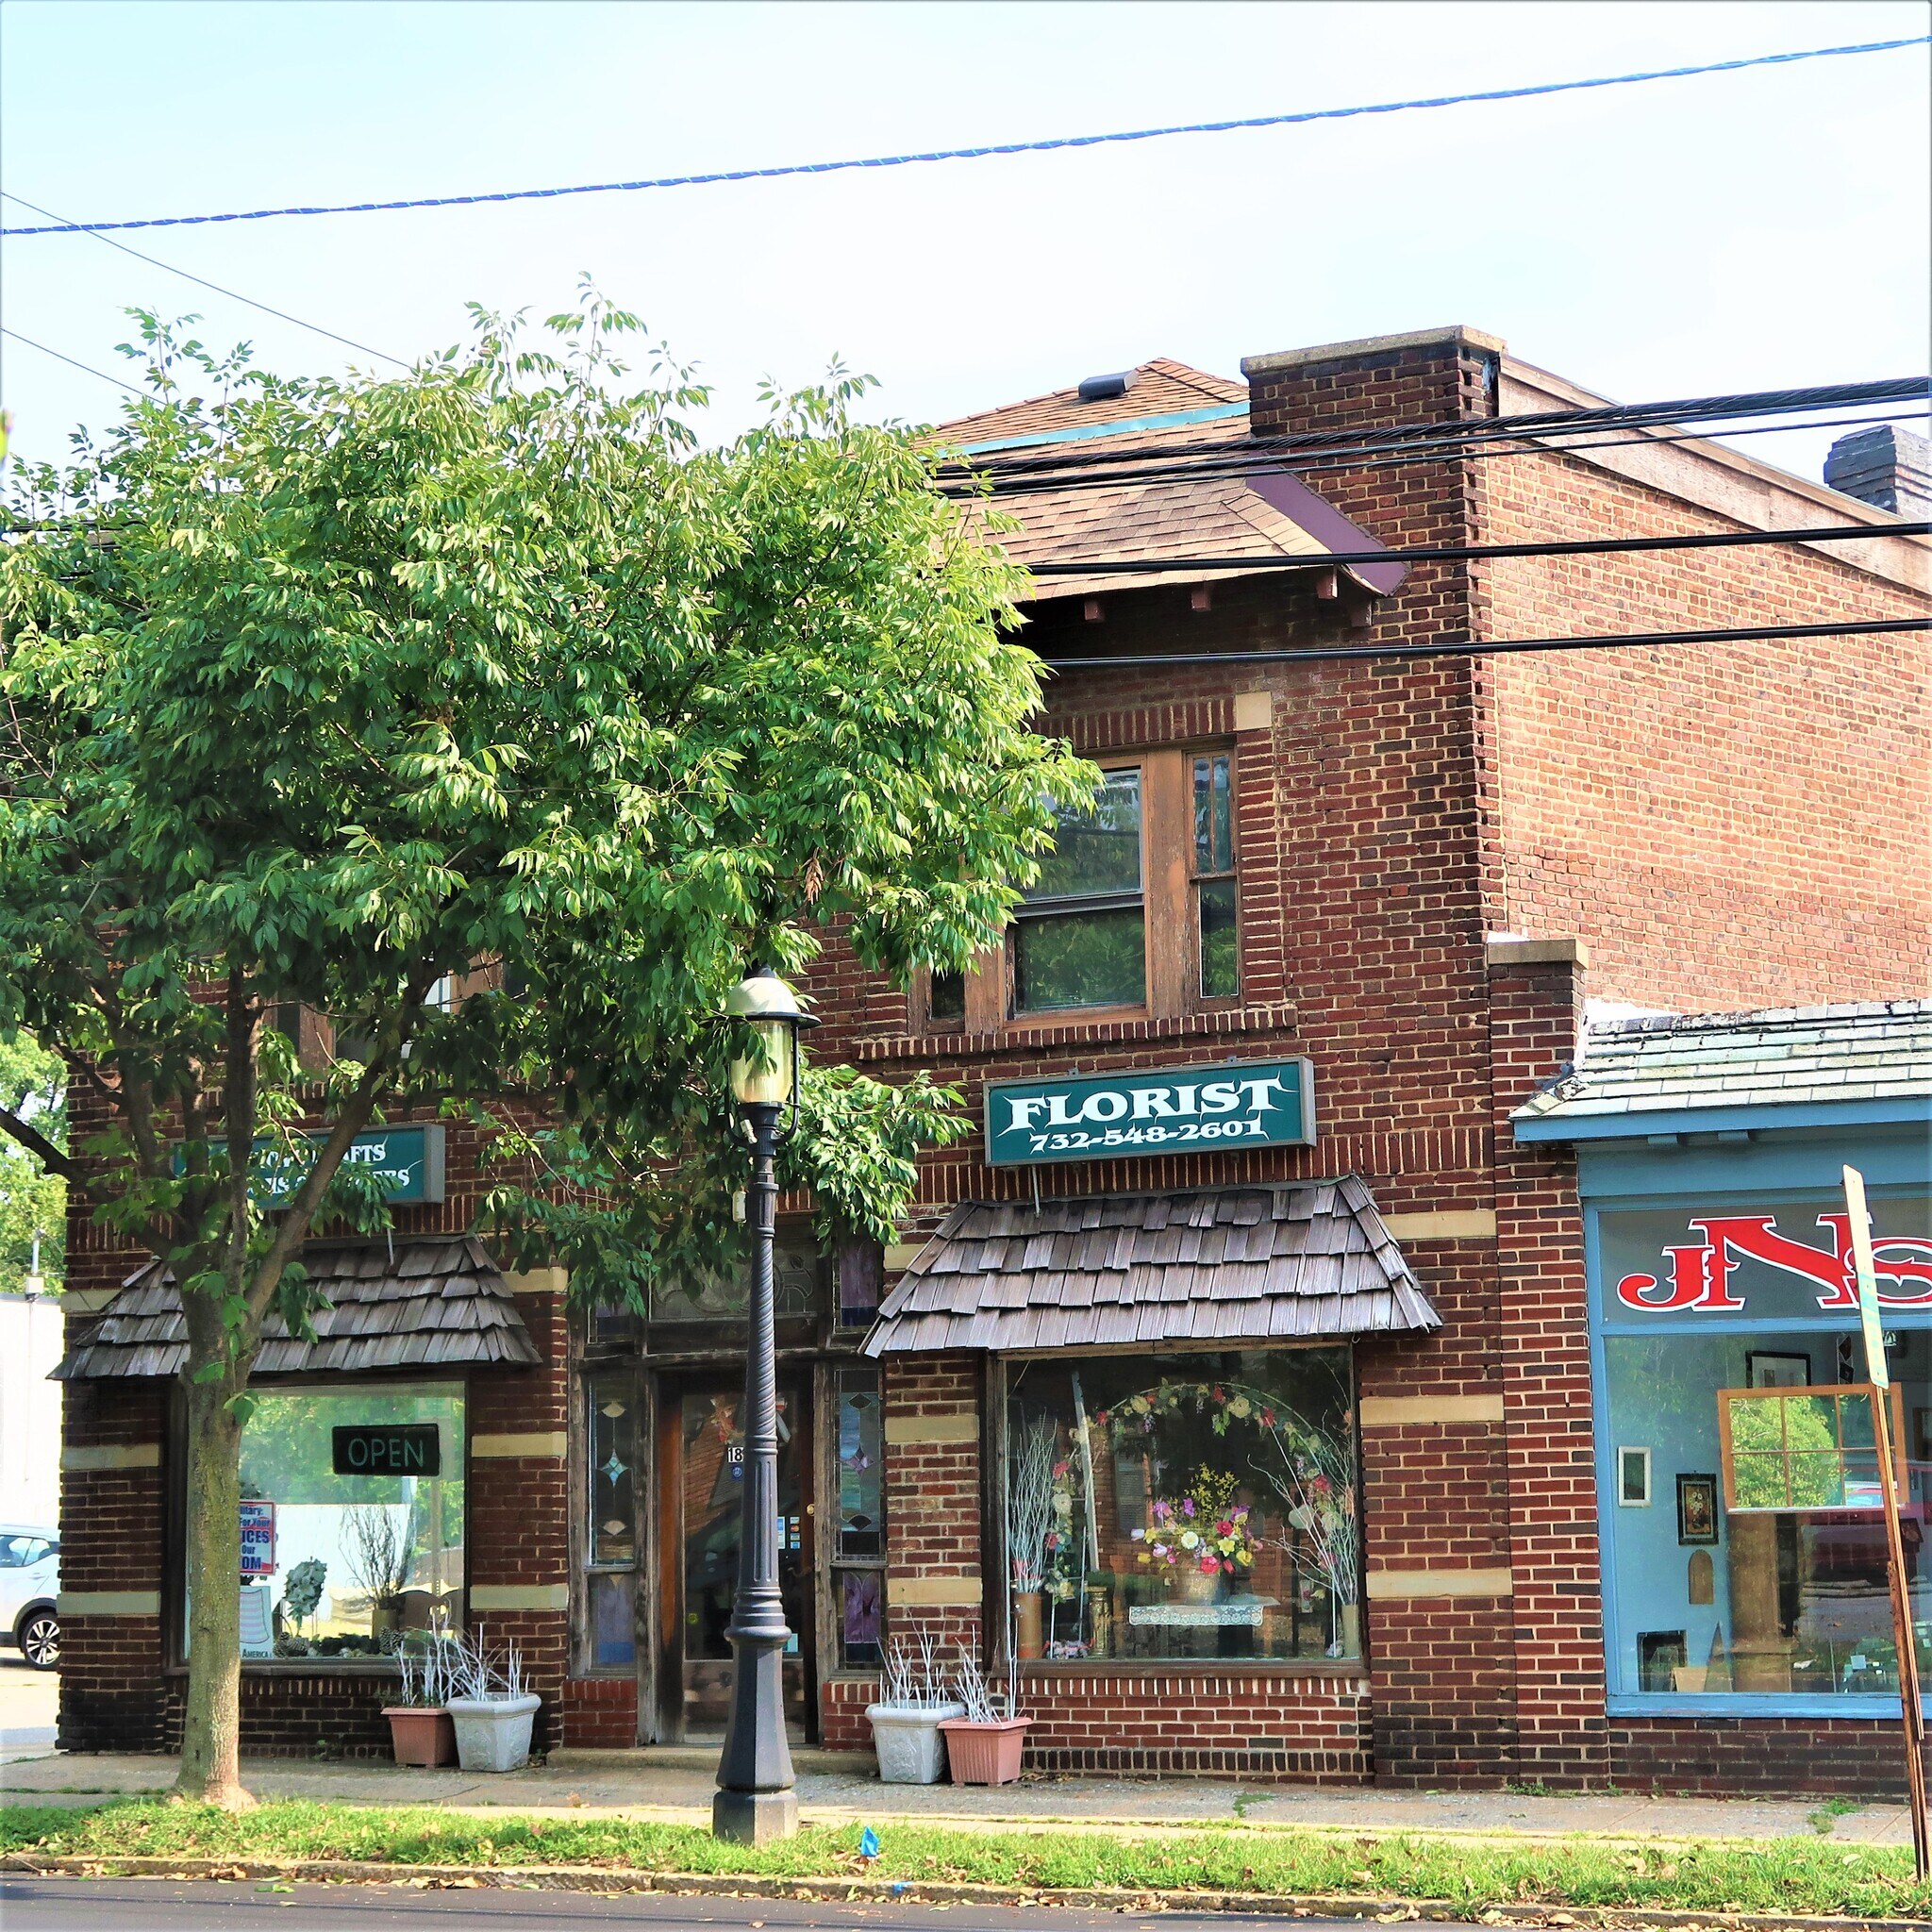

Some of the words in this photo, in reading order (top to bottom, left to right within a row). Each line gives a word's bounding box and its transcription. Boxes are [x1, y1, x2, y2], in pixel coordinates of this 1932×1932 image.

[996, 1070, 1300, 1138] FLORIST
[1029, 1110, 1271, 1156] 732-548-2601
[348, 1438, 424, 1467] OPEN
[242, 1530, 270, 1543] ICES
[242, 1544, 256, 1555] Our
[242, 1557, 261, 1570] OM
